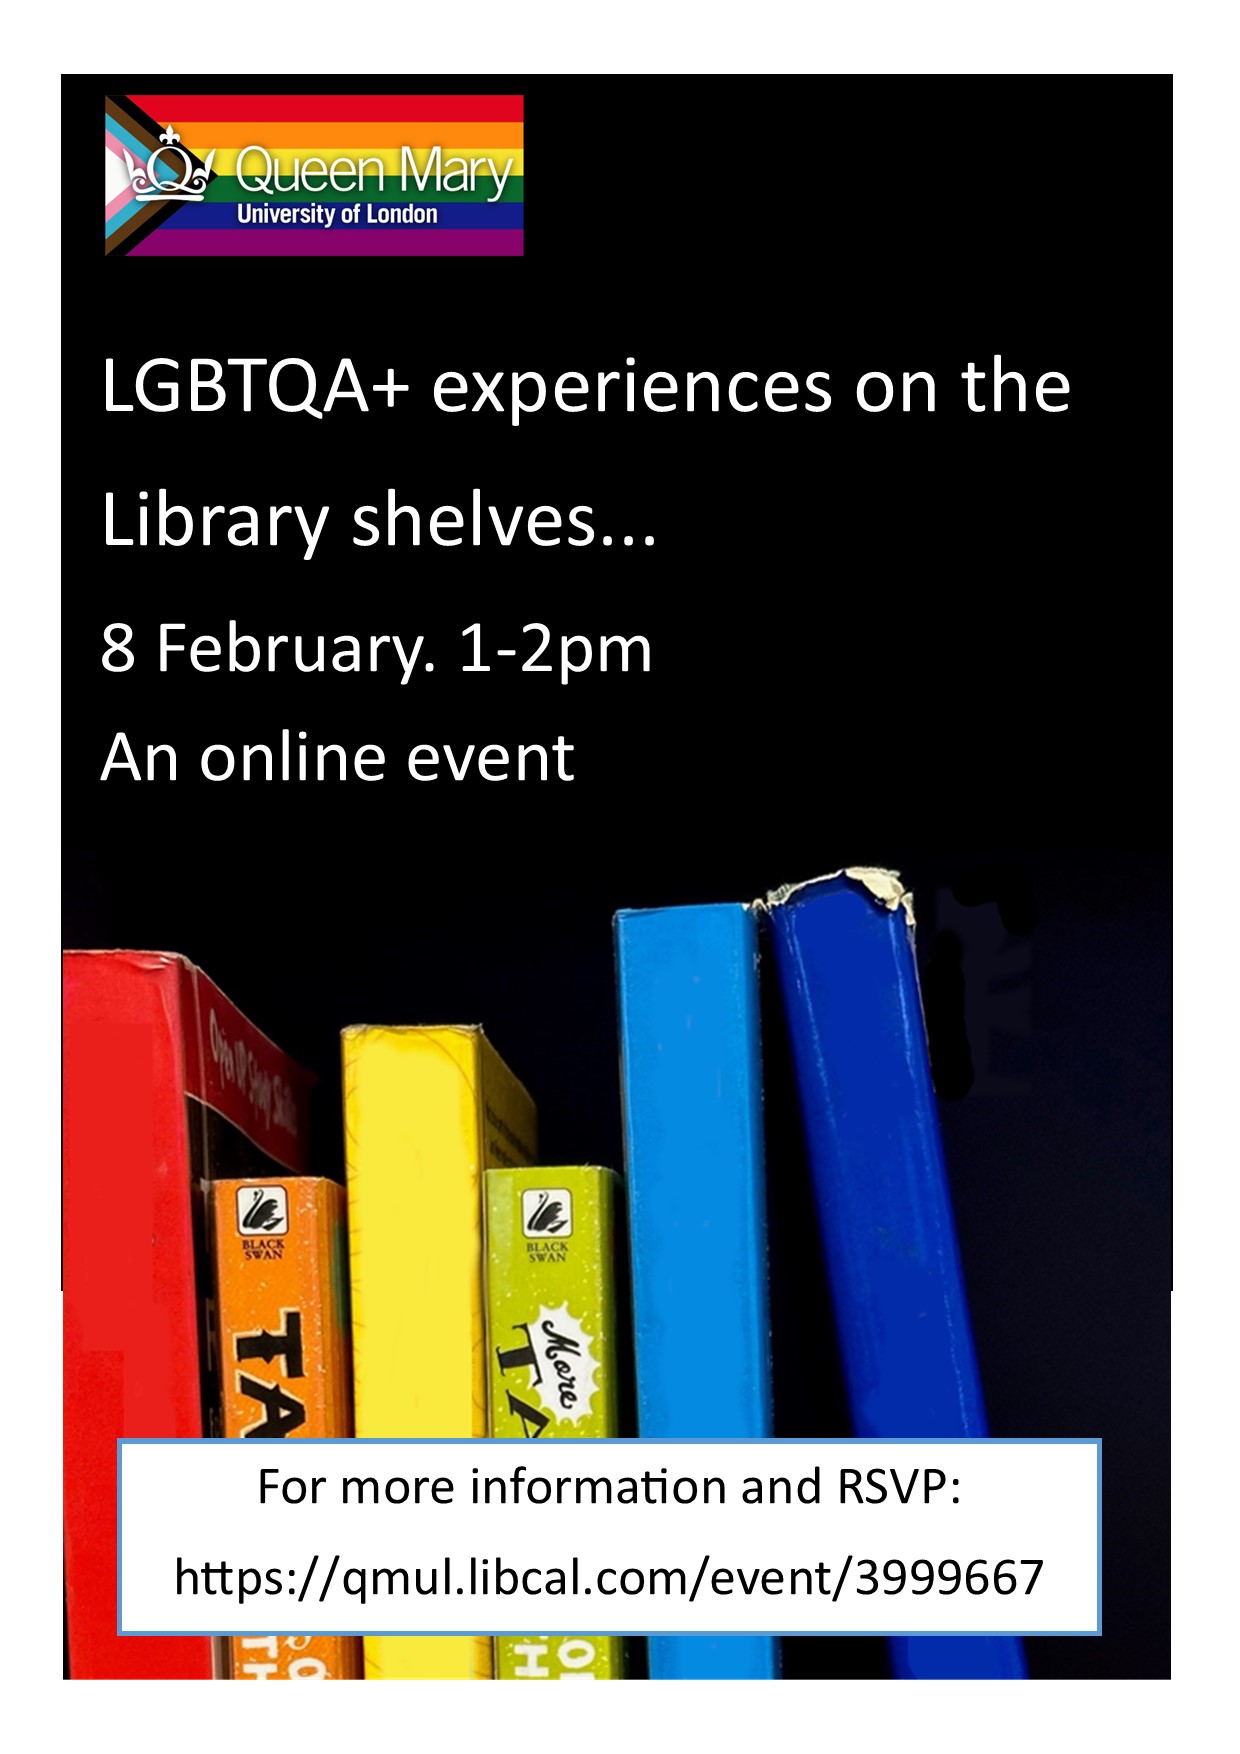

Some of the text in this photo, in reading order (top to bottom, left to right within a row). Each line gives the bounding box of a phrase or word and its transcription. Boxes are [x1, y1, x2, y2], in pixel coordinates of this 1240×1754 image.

[236, 145, 514, 203] Queen Mary
[237, 203, 438, 228] University of London
[105, 354, 1070, 427] LGBTQA+ experiences on the
[105, 488, 656, 561] Library shelves...
[101, 619, 651, 686] 8 February. 1-2pm
[99, 728, 575, 782] An online event
[242, 1239, 285, 1250] BLACK
[244, 1249, 283, 1261] SWAN
[526, 1241, 569, 1252] BLACK
[528, 1252, 567, 1264] SWAN
[541, 1320, 582, 1410] More
[260, 1465, 959, 1504] For more information and RSVP:
[176, 1555, 1044, 1605] https://qmul.libcal.com/event/3999667
